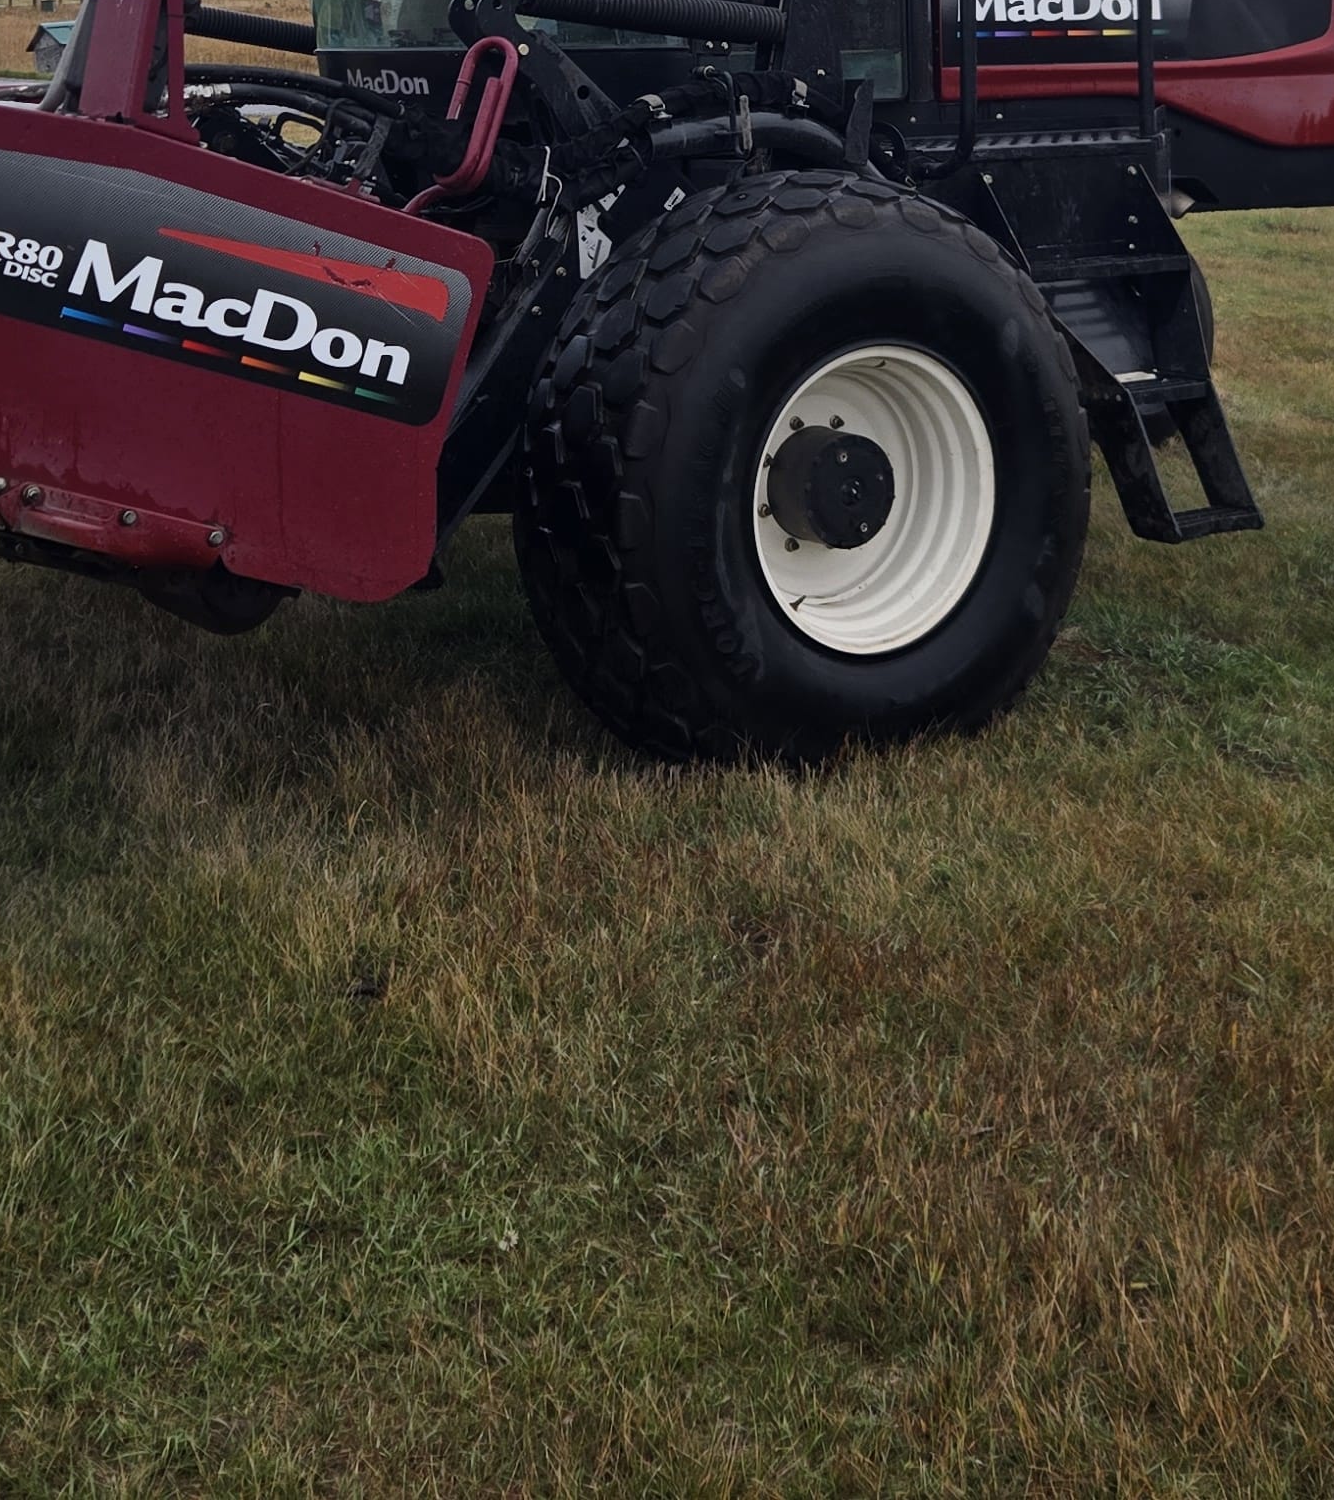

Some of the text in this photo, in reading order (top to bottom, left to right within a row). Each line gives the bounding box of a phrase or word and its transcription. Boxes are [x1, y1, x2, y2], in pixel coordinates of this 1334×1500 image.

[347, 68, 430, 95] MacDon
[3, 260, 59, 288] DISC
[67, 238, 411, 386] MacDon
